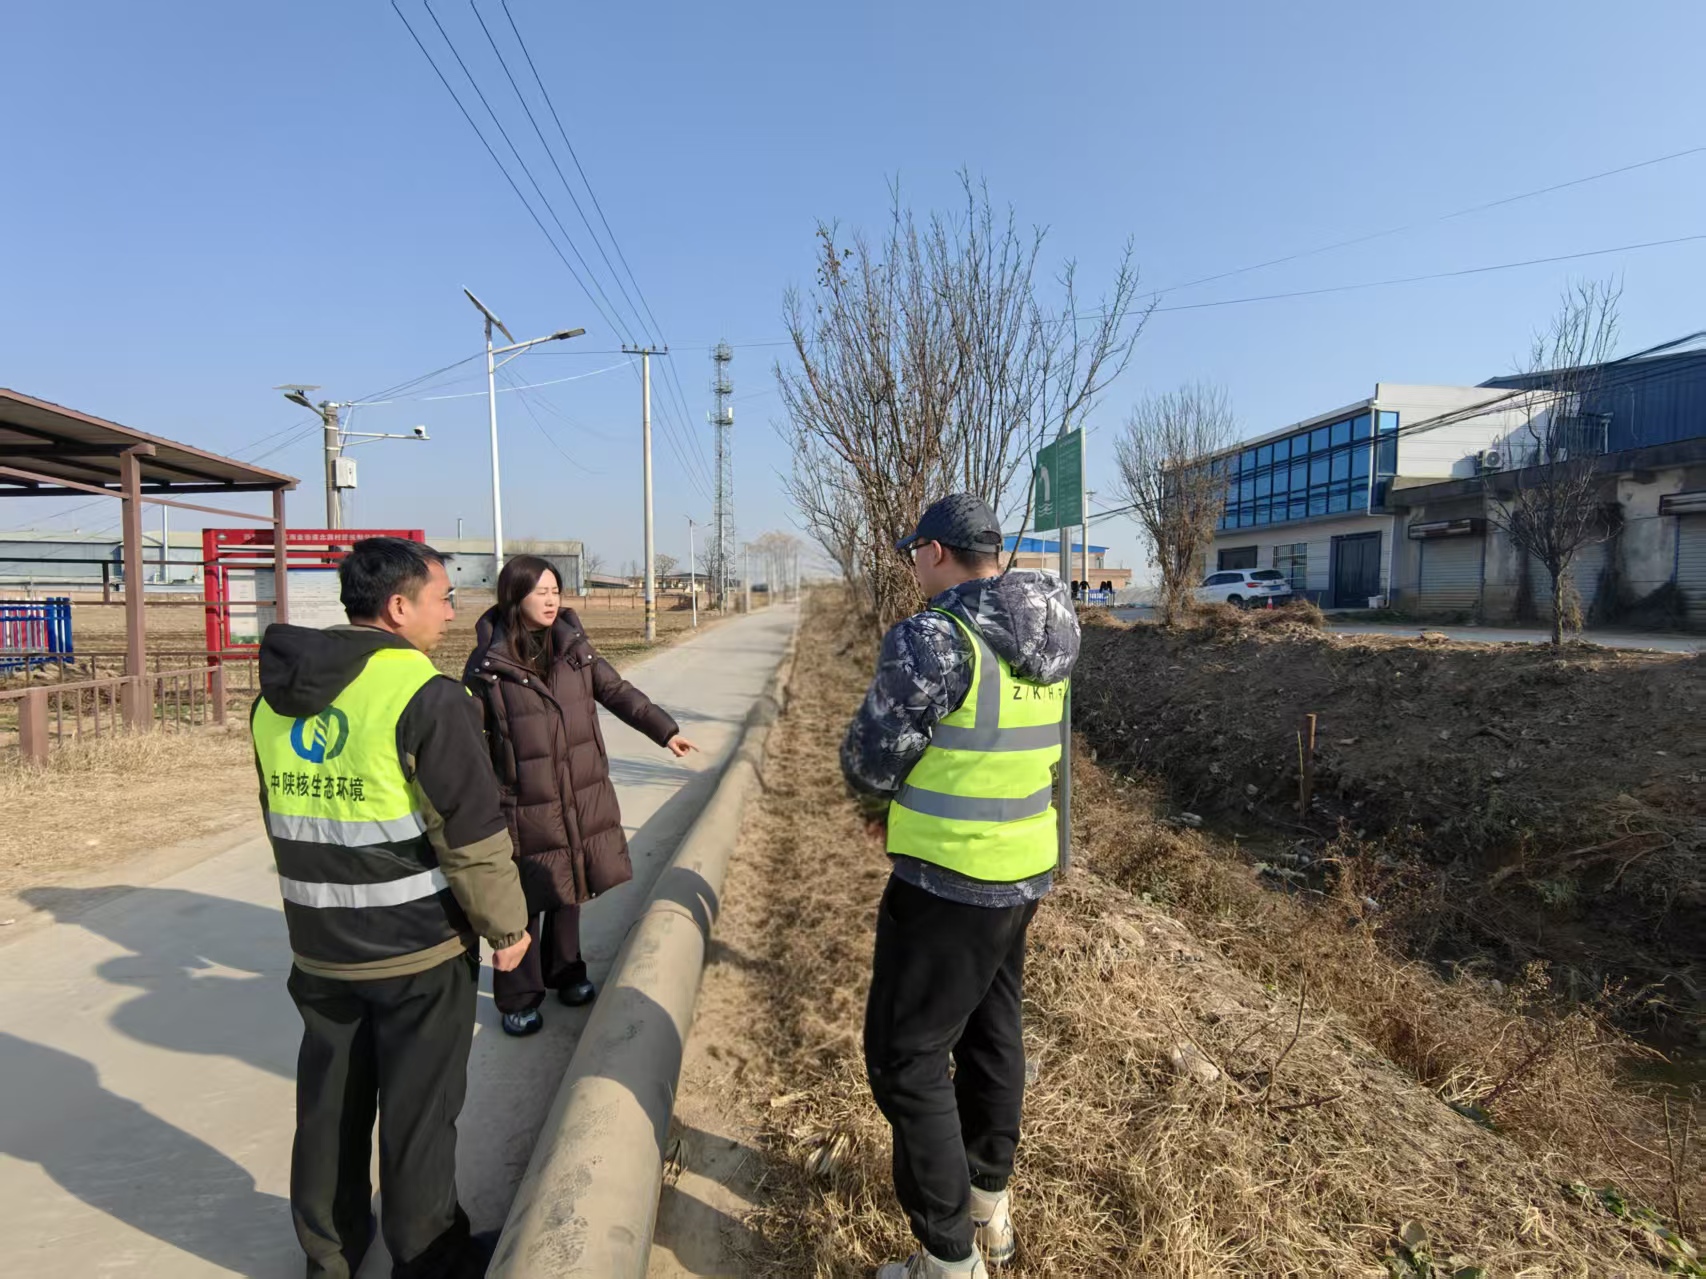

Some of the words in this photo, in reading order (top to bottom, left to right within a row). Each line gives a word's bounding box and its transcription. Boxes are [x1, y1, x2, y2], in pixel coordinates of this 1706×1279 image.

[271, 770, 365, 802] 中陕核生态环境
